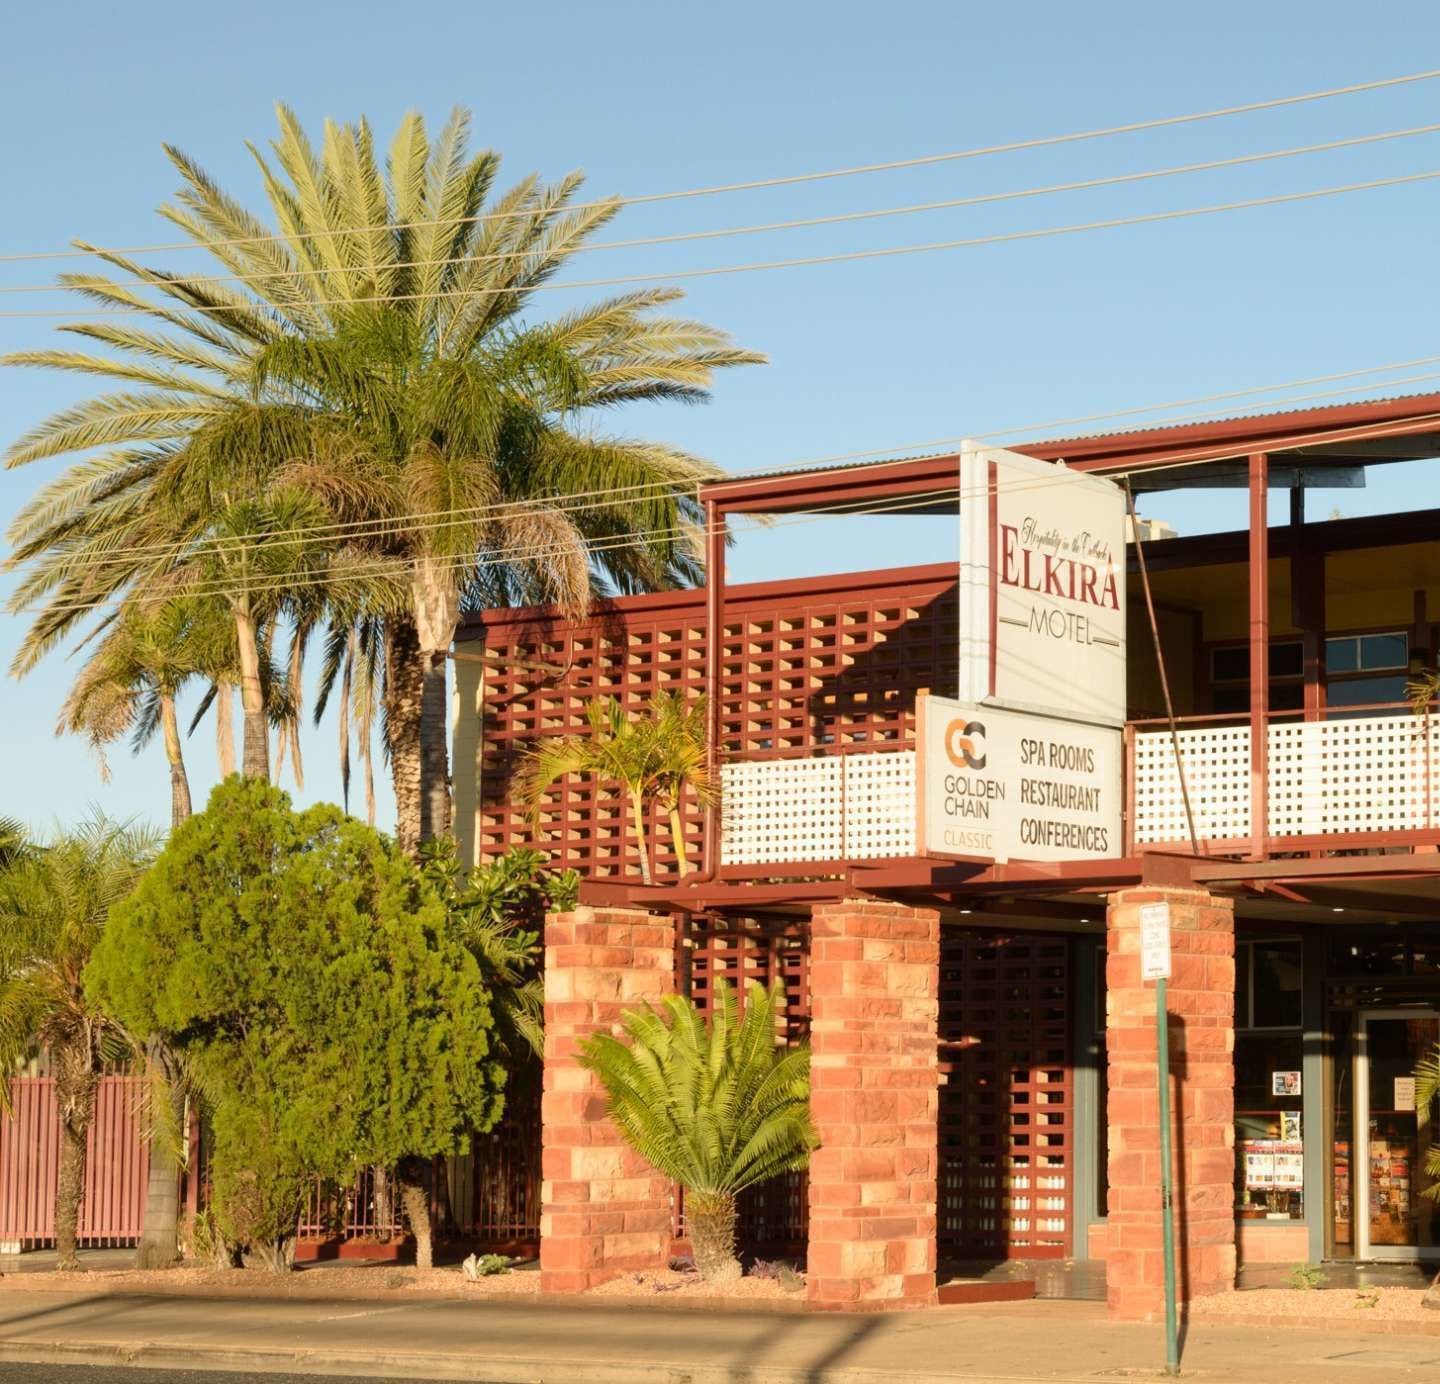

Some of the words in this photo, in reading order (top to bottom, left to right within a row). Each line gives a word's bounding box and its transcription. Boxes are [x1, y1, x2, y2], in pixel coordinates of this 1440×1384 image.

[1000, 523, 1120, 611] ELKIRA
[1029, 606, 1093, 645] MOTEL
[1020, 738, 1046, 767] SPA
[1050, 742, 1095, 773] ROOMS
[944, 774, 1006, 800] GOLDEN
[1020, 778, 1101, 812] RESTAURANT
[944, 796, 989, 820] CHAIN
[944, 830, 993, 851] CLASSIC
[1020, 817, 1108, 852] CONFERENCES
